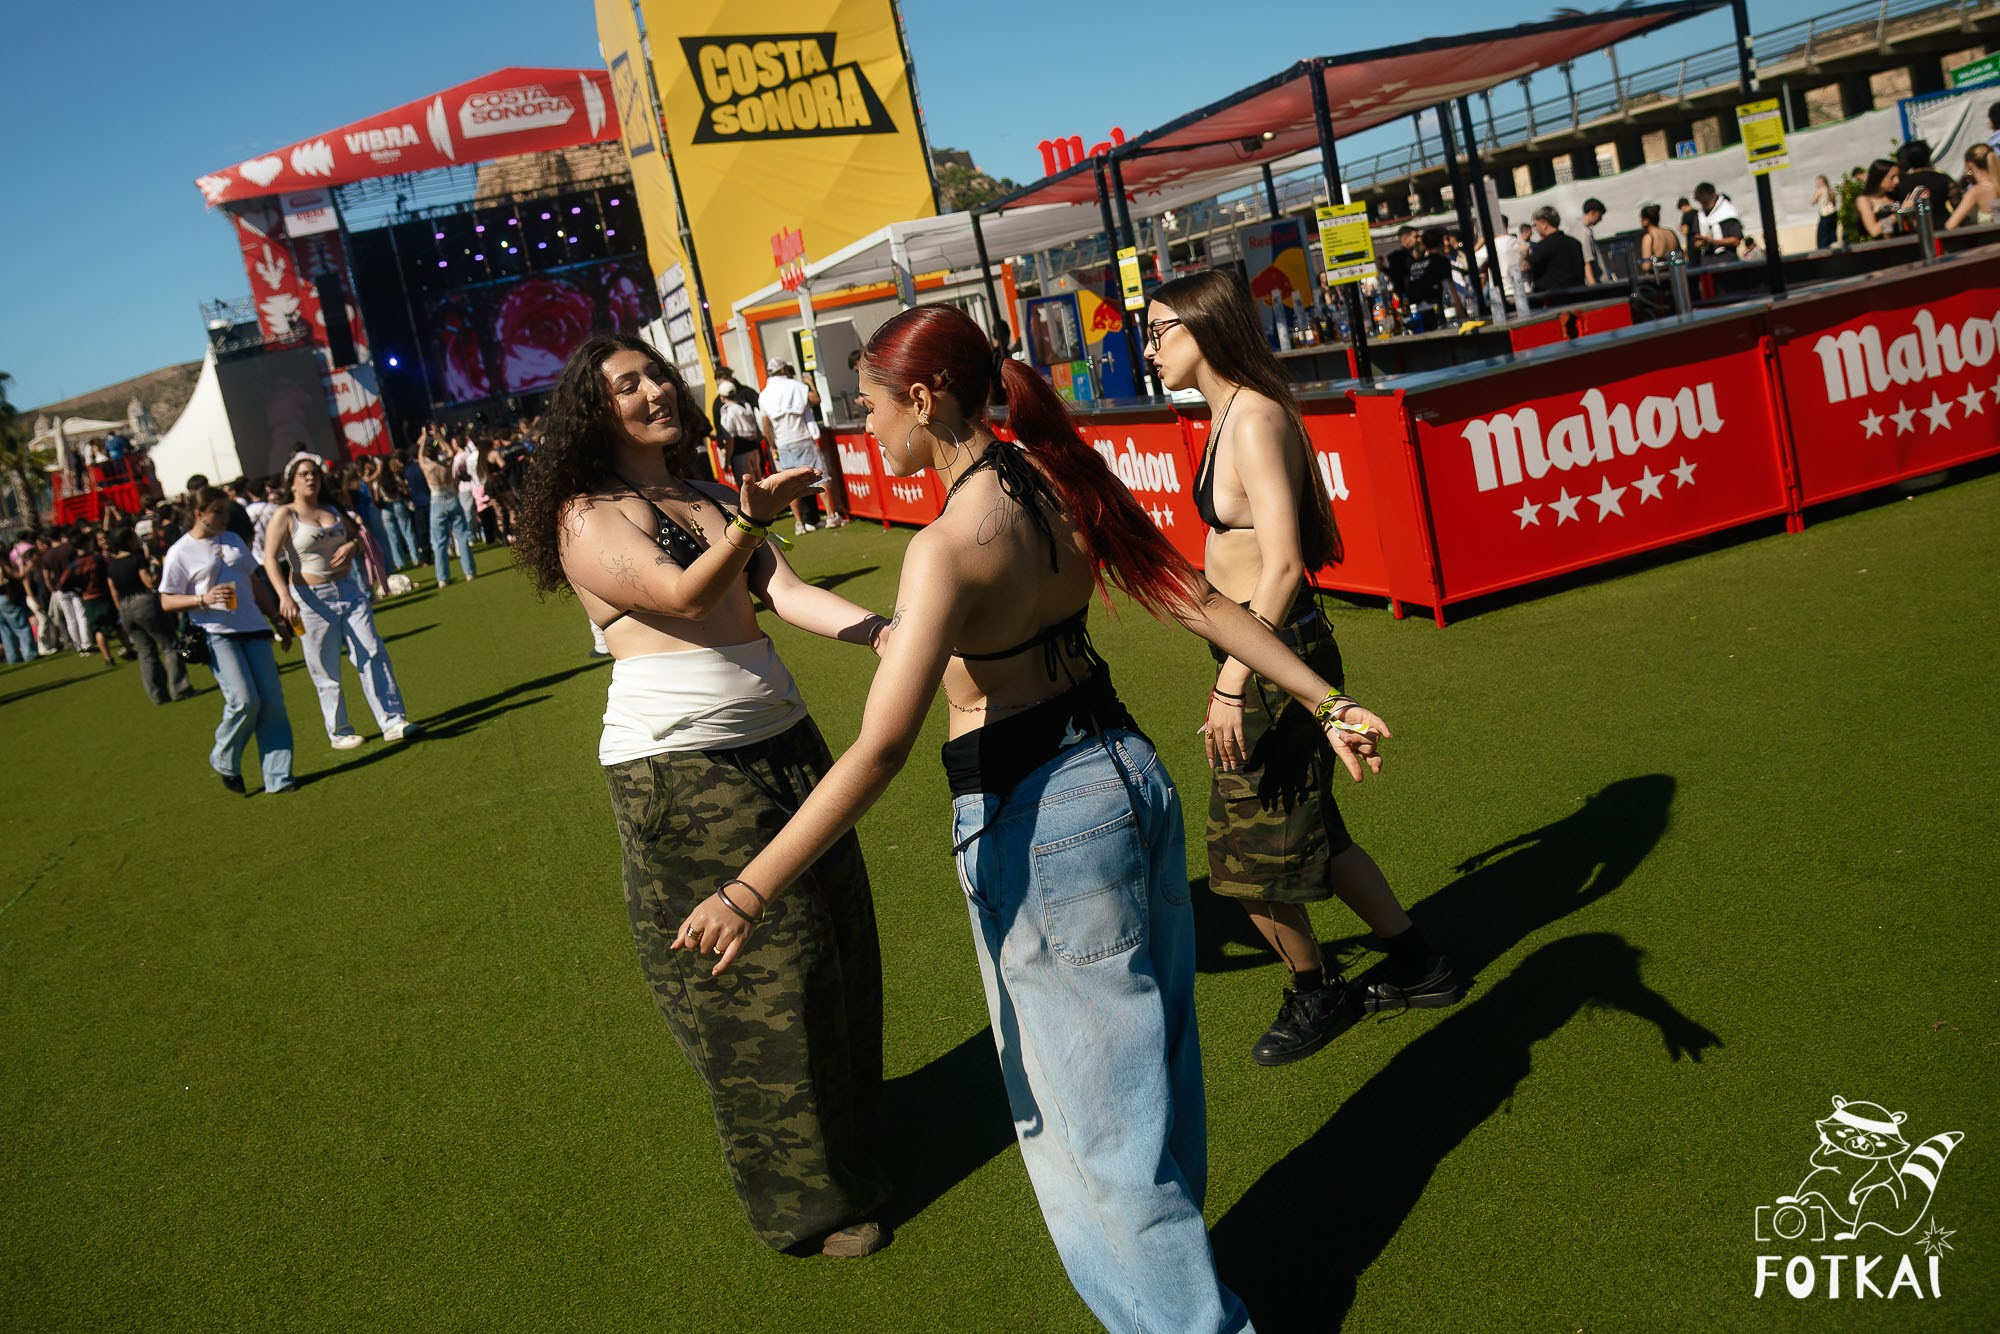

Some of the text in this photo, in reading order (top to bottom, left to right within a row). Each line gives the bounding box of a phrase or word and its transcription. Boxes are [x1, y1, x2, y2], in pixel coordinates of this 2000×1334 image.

[698, 39, 828, 104] COSTA
[469, 88, 547, 108] COSTA
[472, 100, 572, 124] SONORA
[711, 67, 872, 135] SONORA
[344, 124, 420, 154] VIBRA
[1460, 382, 1725, 492] Mahou
